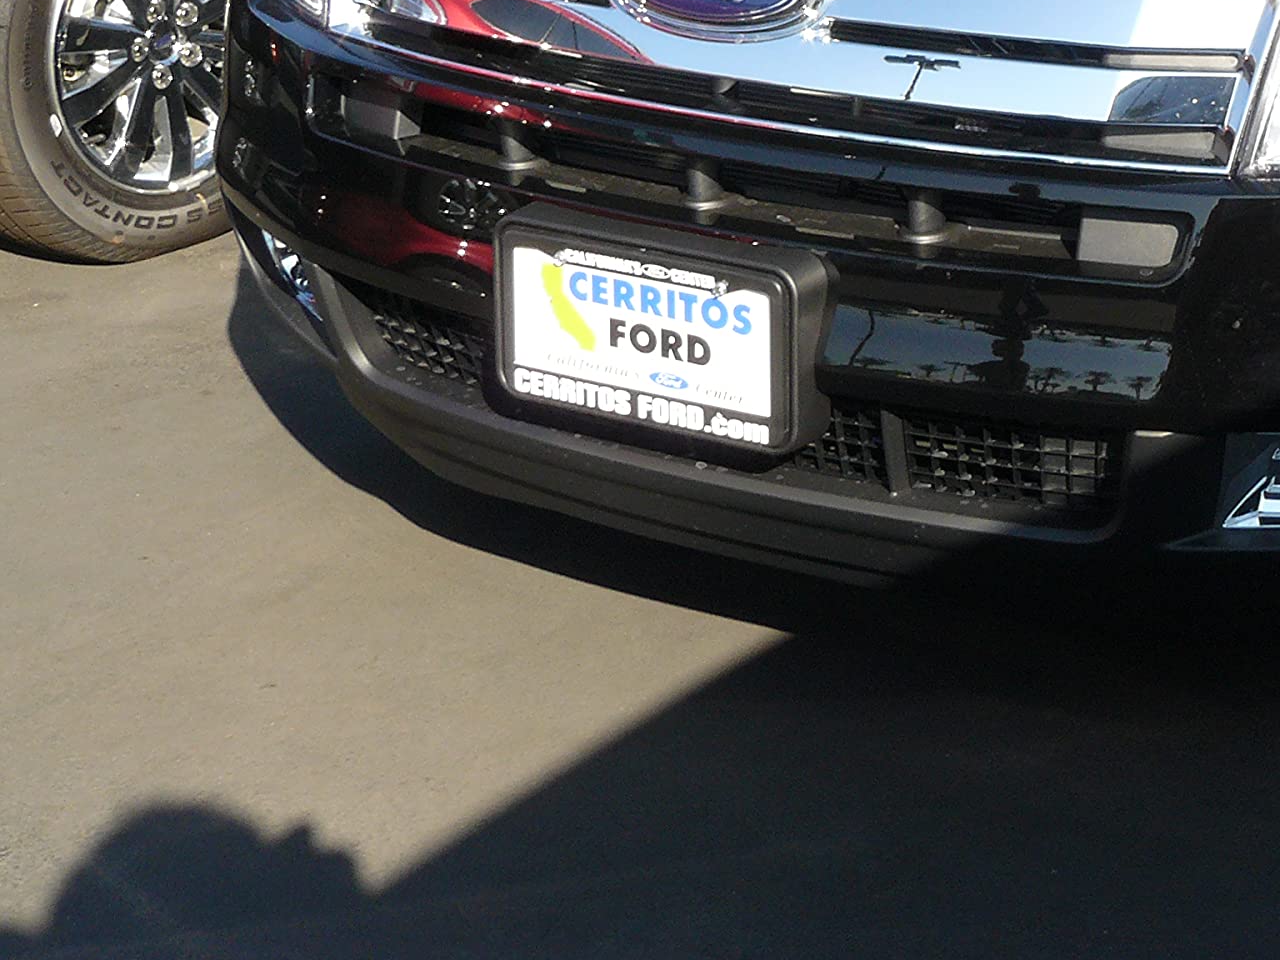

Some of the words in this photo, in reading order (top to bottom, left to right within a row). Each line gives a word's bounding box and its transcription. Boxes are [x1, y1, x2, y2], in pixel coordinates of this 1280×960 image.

[51, 160, 178, 230] CONTACT
[671, 268, 716, 289] CENTER
[569, 271, 752, 336] CERRITOS
[610, 318, 711, 366] FORD
[513, 368, 632, 416] CERRITOS
